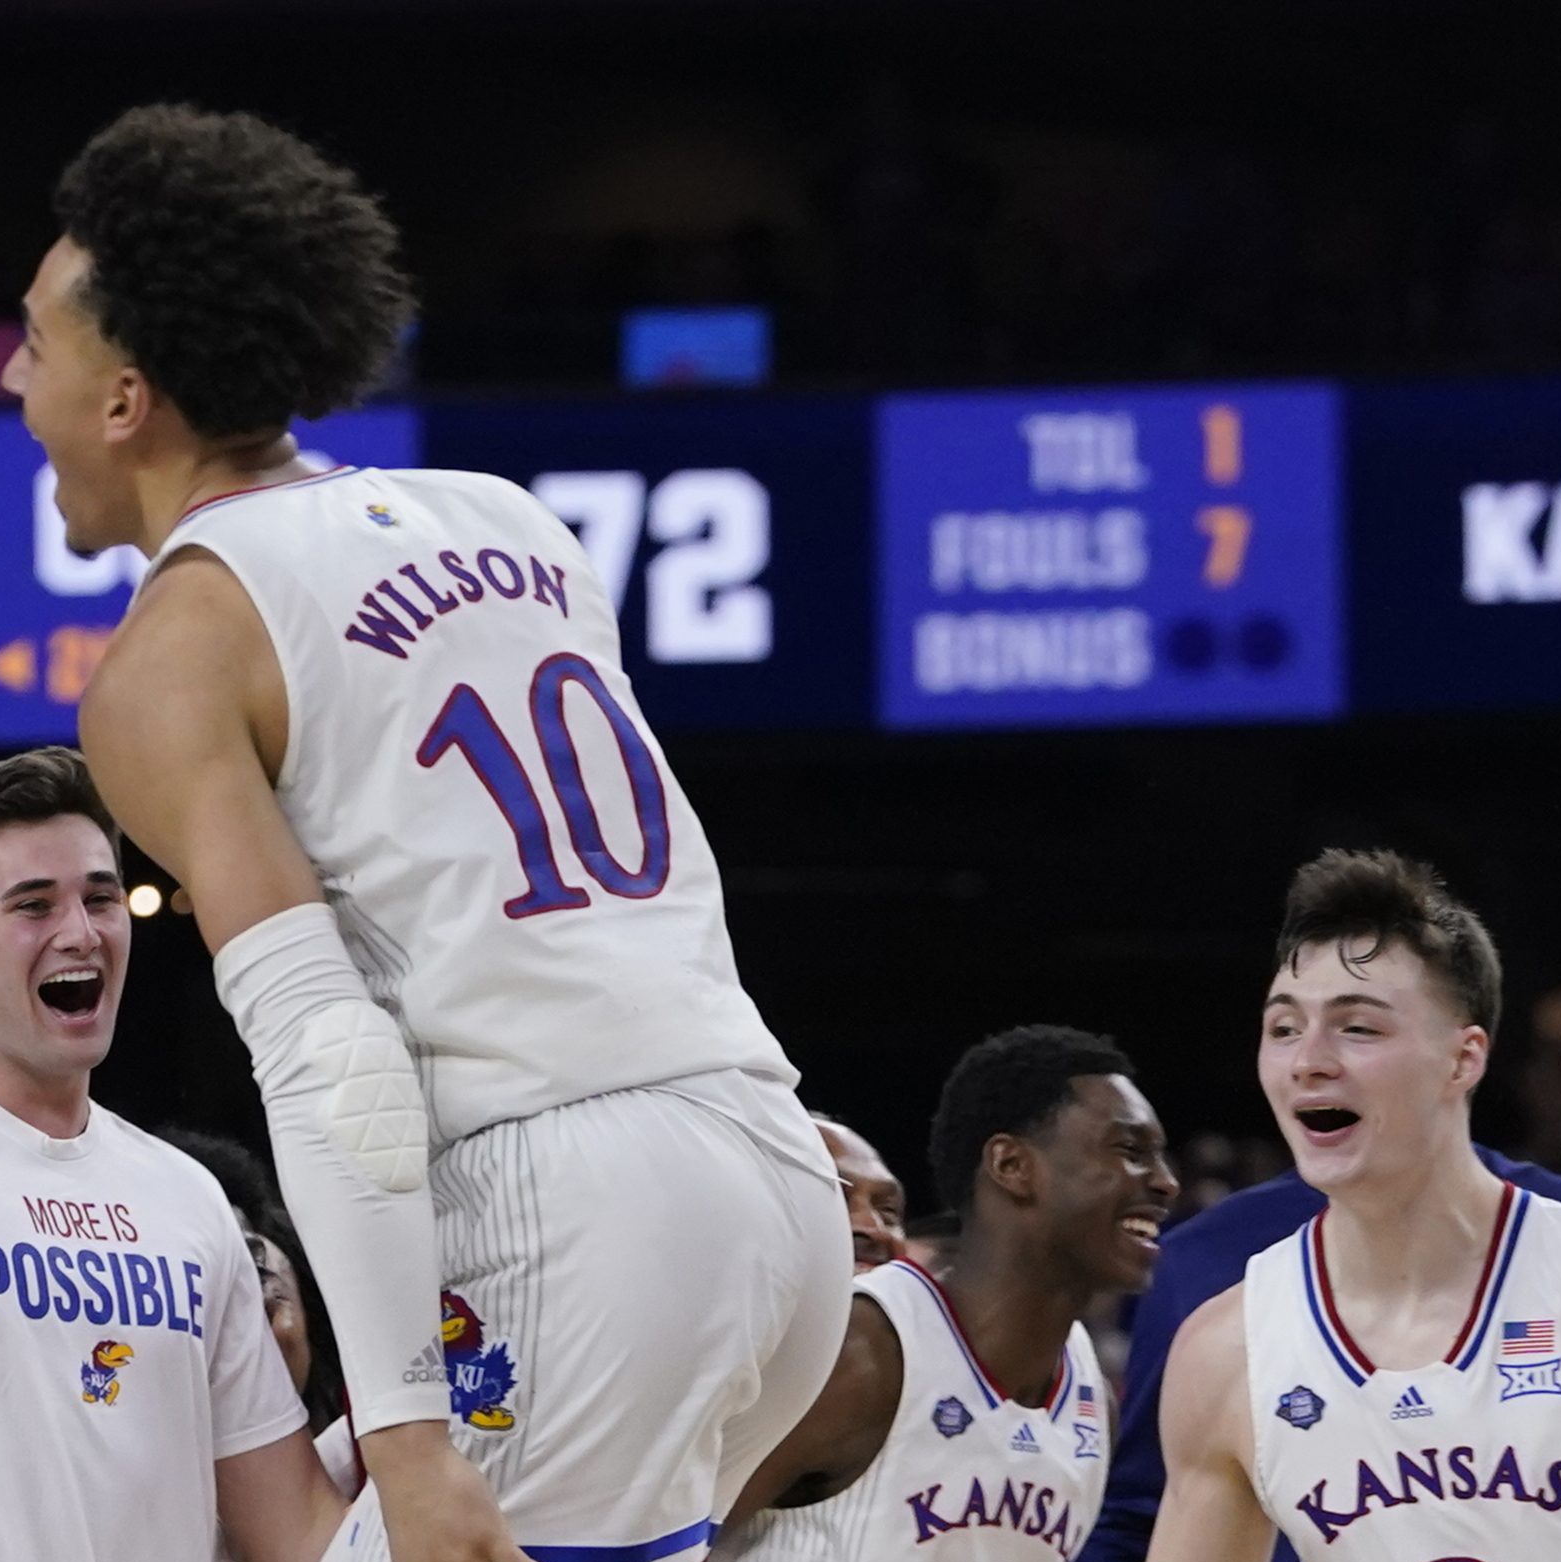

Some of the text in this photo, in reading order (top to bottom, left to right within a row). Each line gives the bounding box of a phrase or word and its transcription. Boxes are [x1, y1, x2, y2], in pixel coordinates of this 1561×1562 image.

[1201, 405, 1242, 486] 1
[530, 467, 773, 664] 72
[928, 504, 1250, 592] FOULS 7
[344, 548, 569, 661] WILSON
[914, 609, 1152, 693] BONUS
[415, 652, 671, 919] 10
[22, 1195, 139, 1243] MORE IS
[455, 1362, 485, 1394] KU
[905, 1476, 1078, 1560] KANSA
